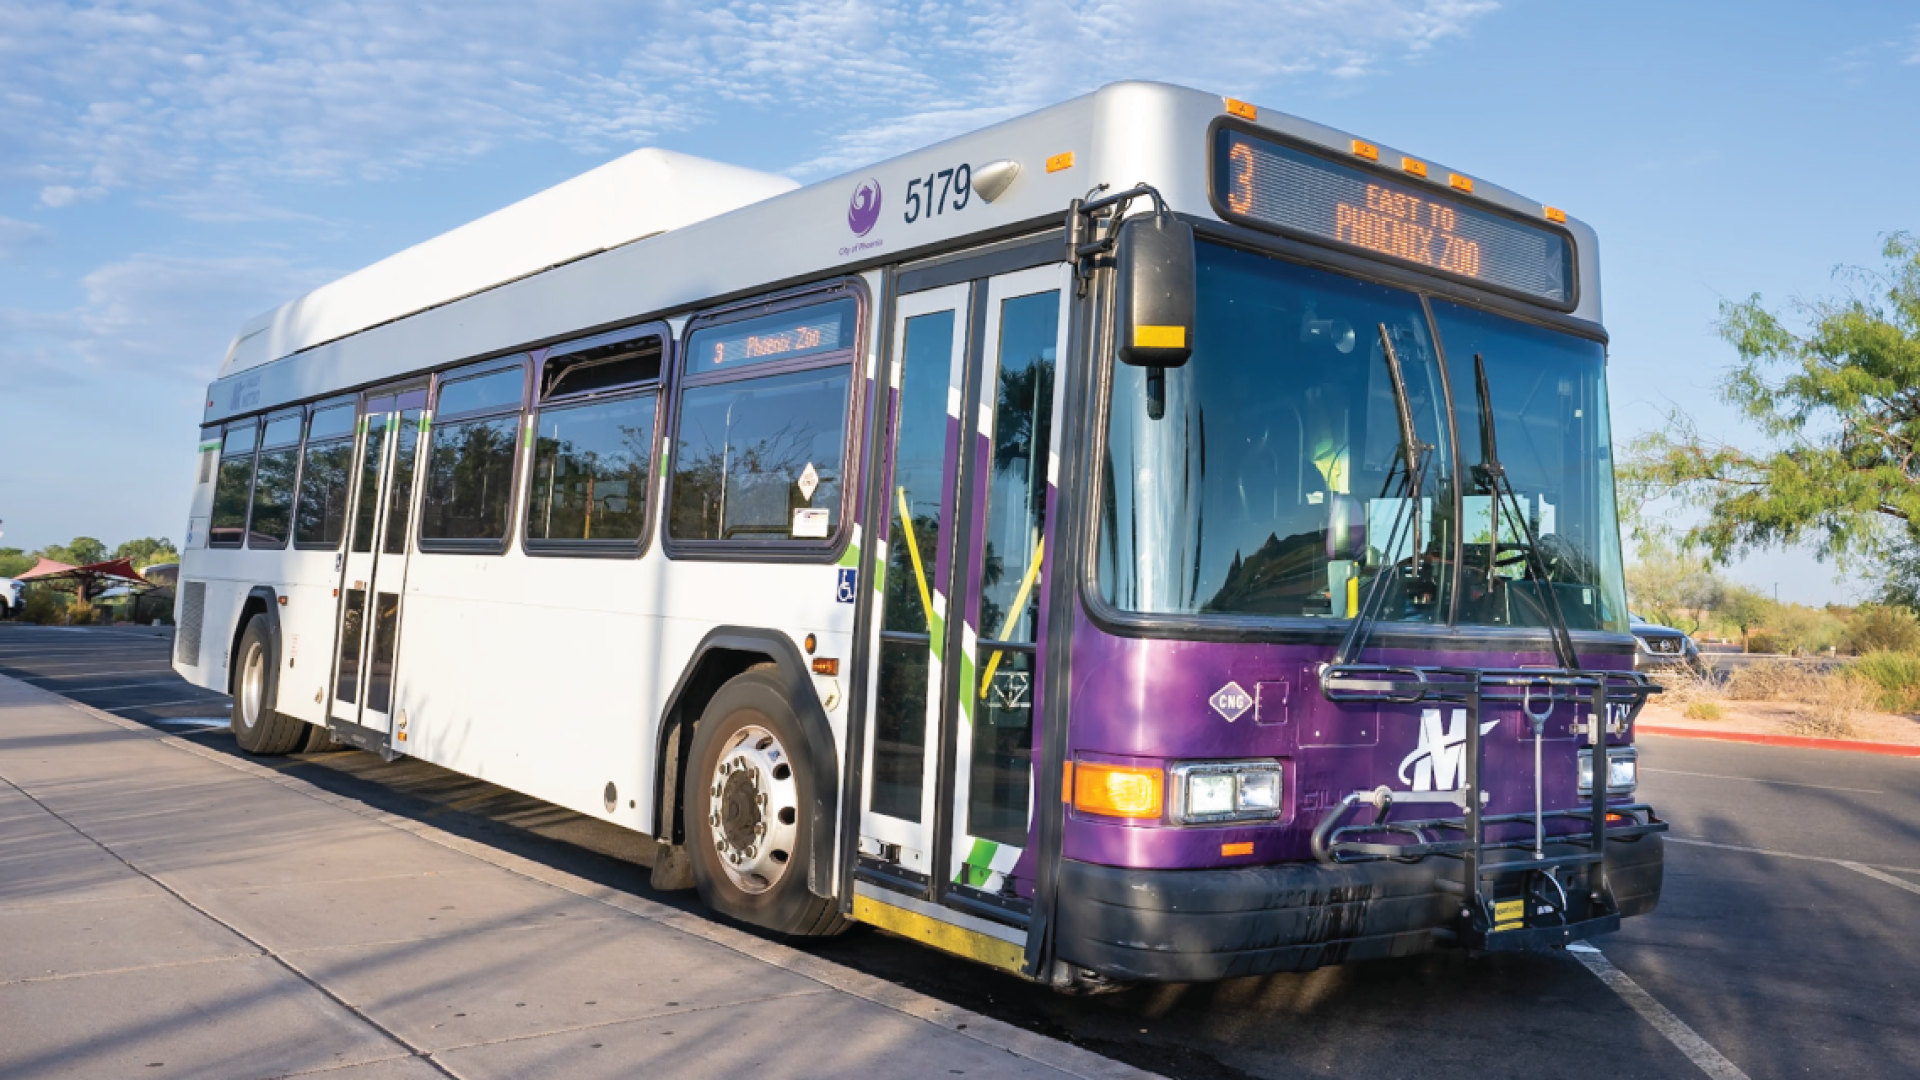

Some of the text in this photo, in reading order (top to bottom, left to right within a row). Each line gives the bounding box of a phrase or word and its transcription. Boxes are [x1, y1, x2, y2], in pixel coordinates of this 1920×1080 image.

[904, 163, 971, 224] 5179
[1228, 143, 1253, 215] 3
[1366, 183, 1455, 231] EAST TO
[1336, 202, 1480, 277] PHOENIX ZOO
[714, 326, 820, 364] 3 Phoenix Zoo
[1219, 694, 1244, 709] CNG
